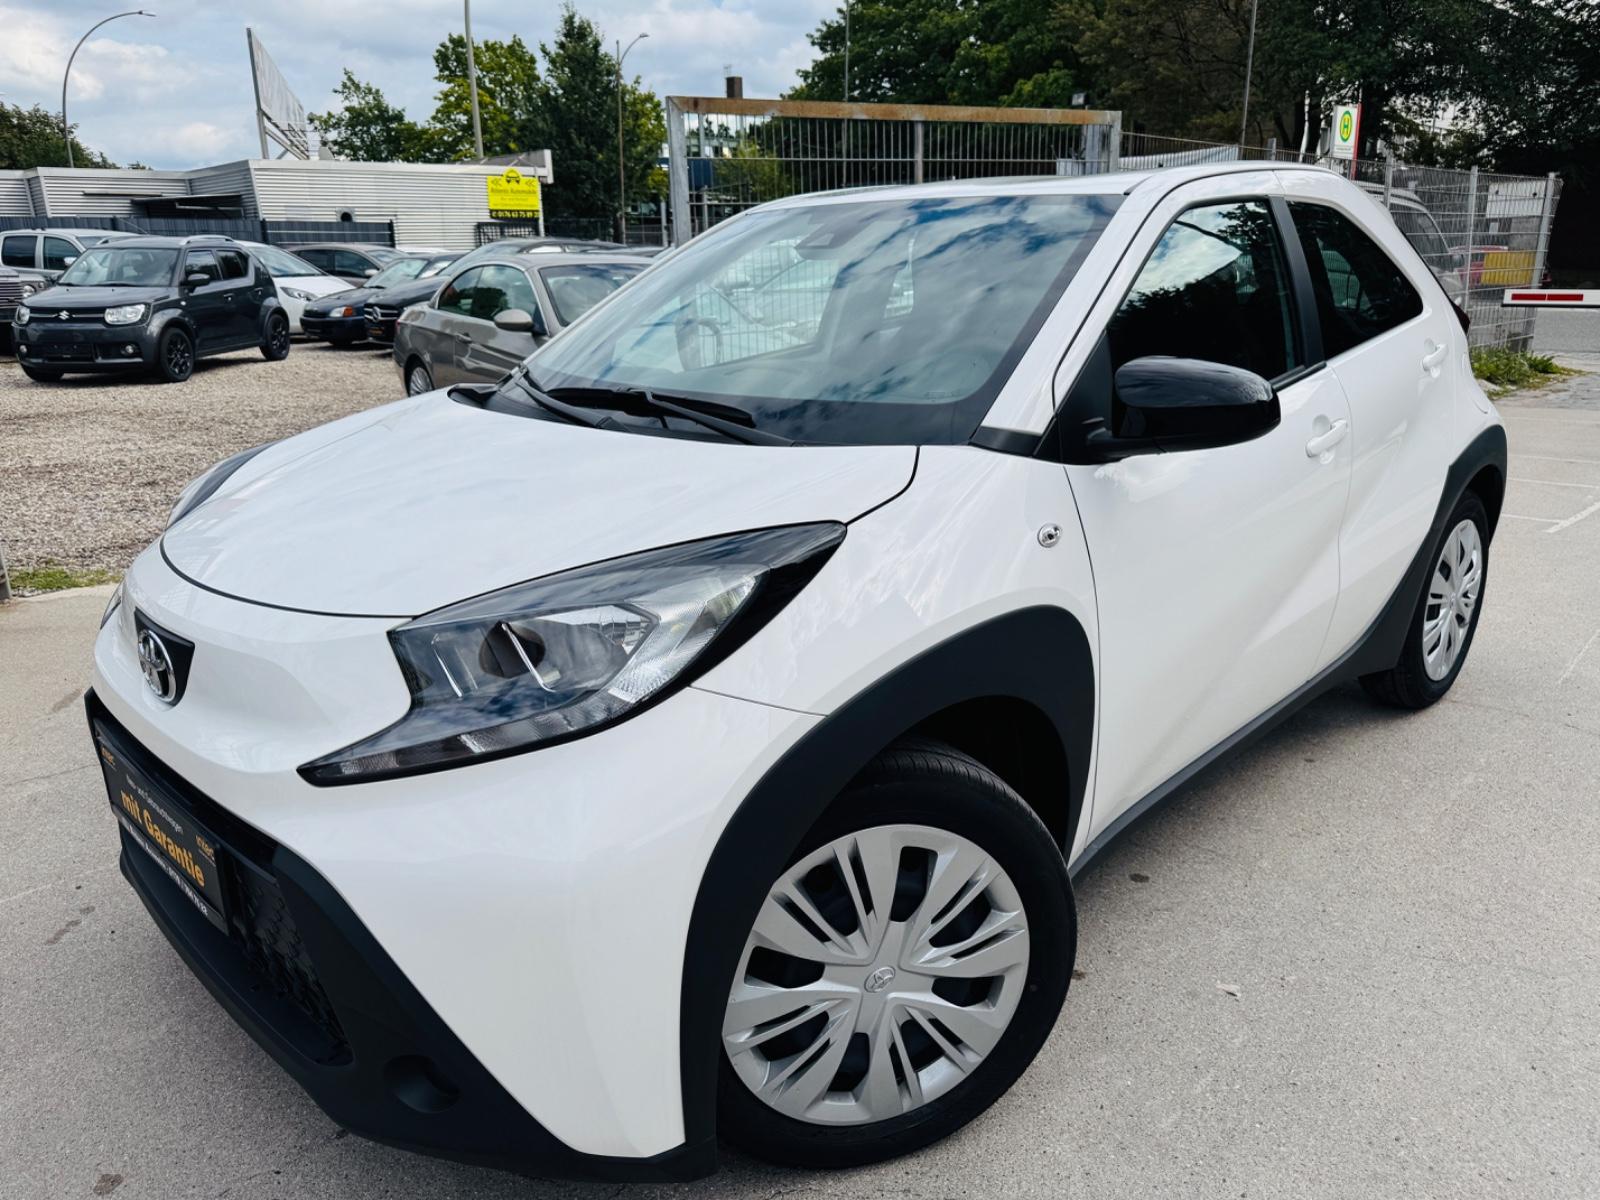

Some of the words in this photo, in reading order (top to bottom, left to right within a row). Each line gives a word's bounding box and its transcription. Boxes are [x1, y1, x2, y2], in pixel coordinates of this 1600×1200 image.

[1343, 117, 1350, 135] H
[121, 789, 142, 824] mit
[143, 809, 205, 887] Garantie
